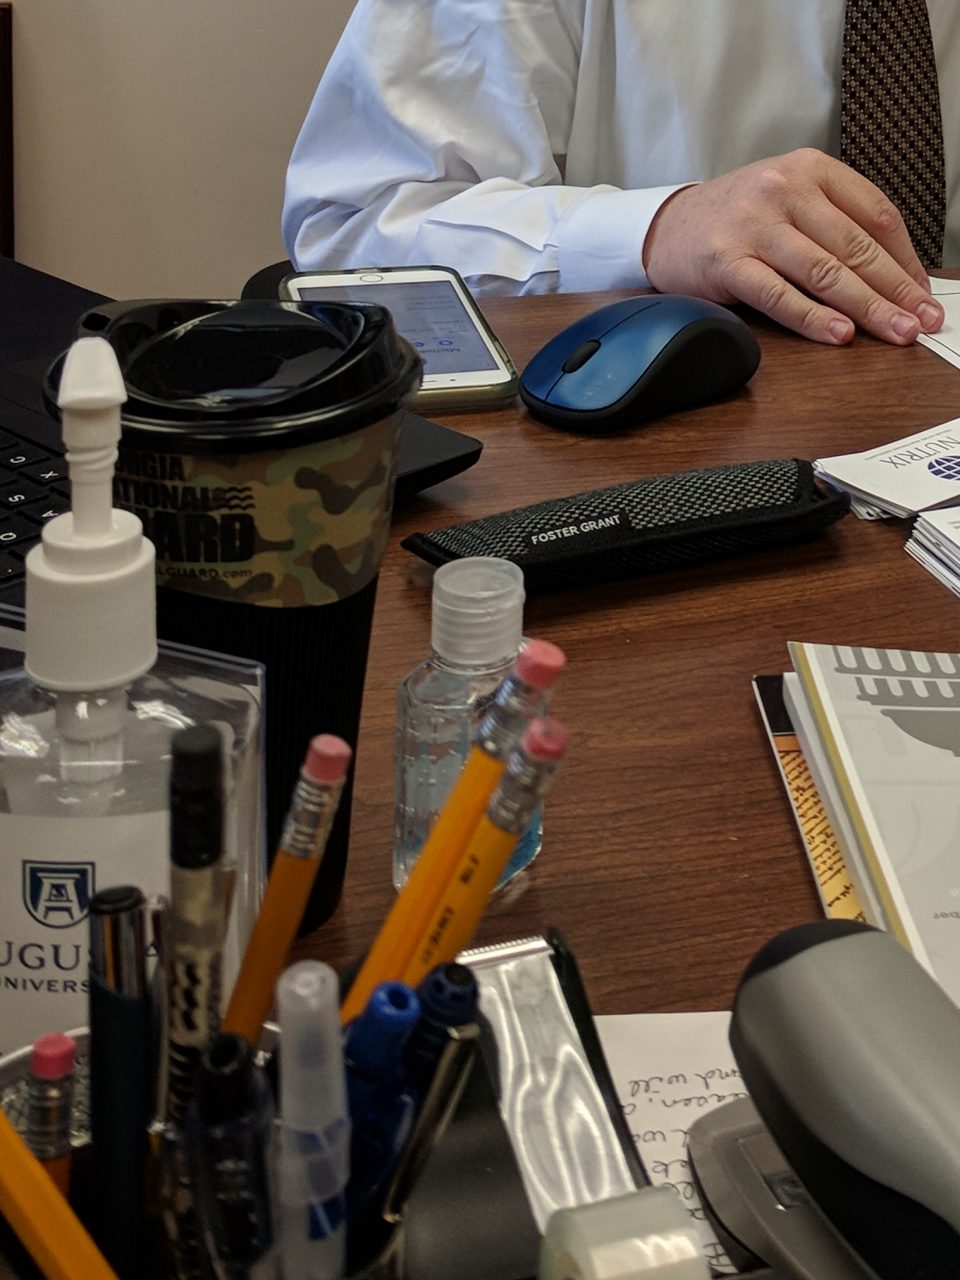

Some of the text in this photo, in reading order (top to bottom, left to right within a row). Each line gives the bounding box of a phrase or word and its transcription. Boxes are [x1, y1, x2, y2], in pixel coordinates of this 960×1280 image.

[40, 470, 58, 480] X
[9, 494, 25, 503] S
[531, 515, 621, 546] FOSTER GRANT
